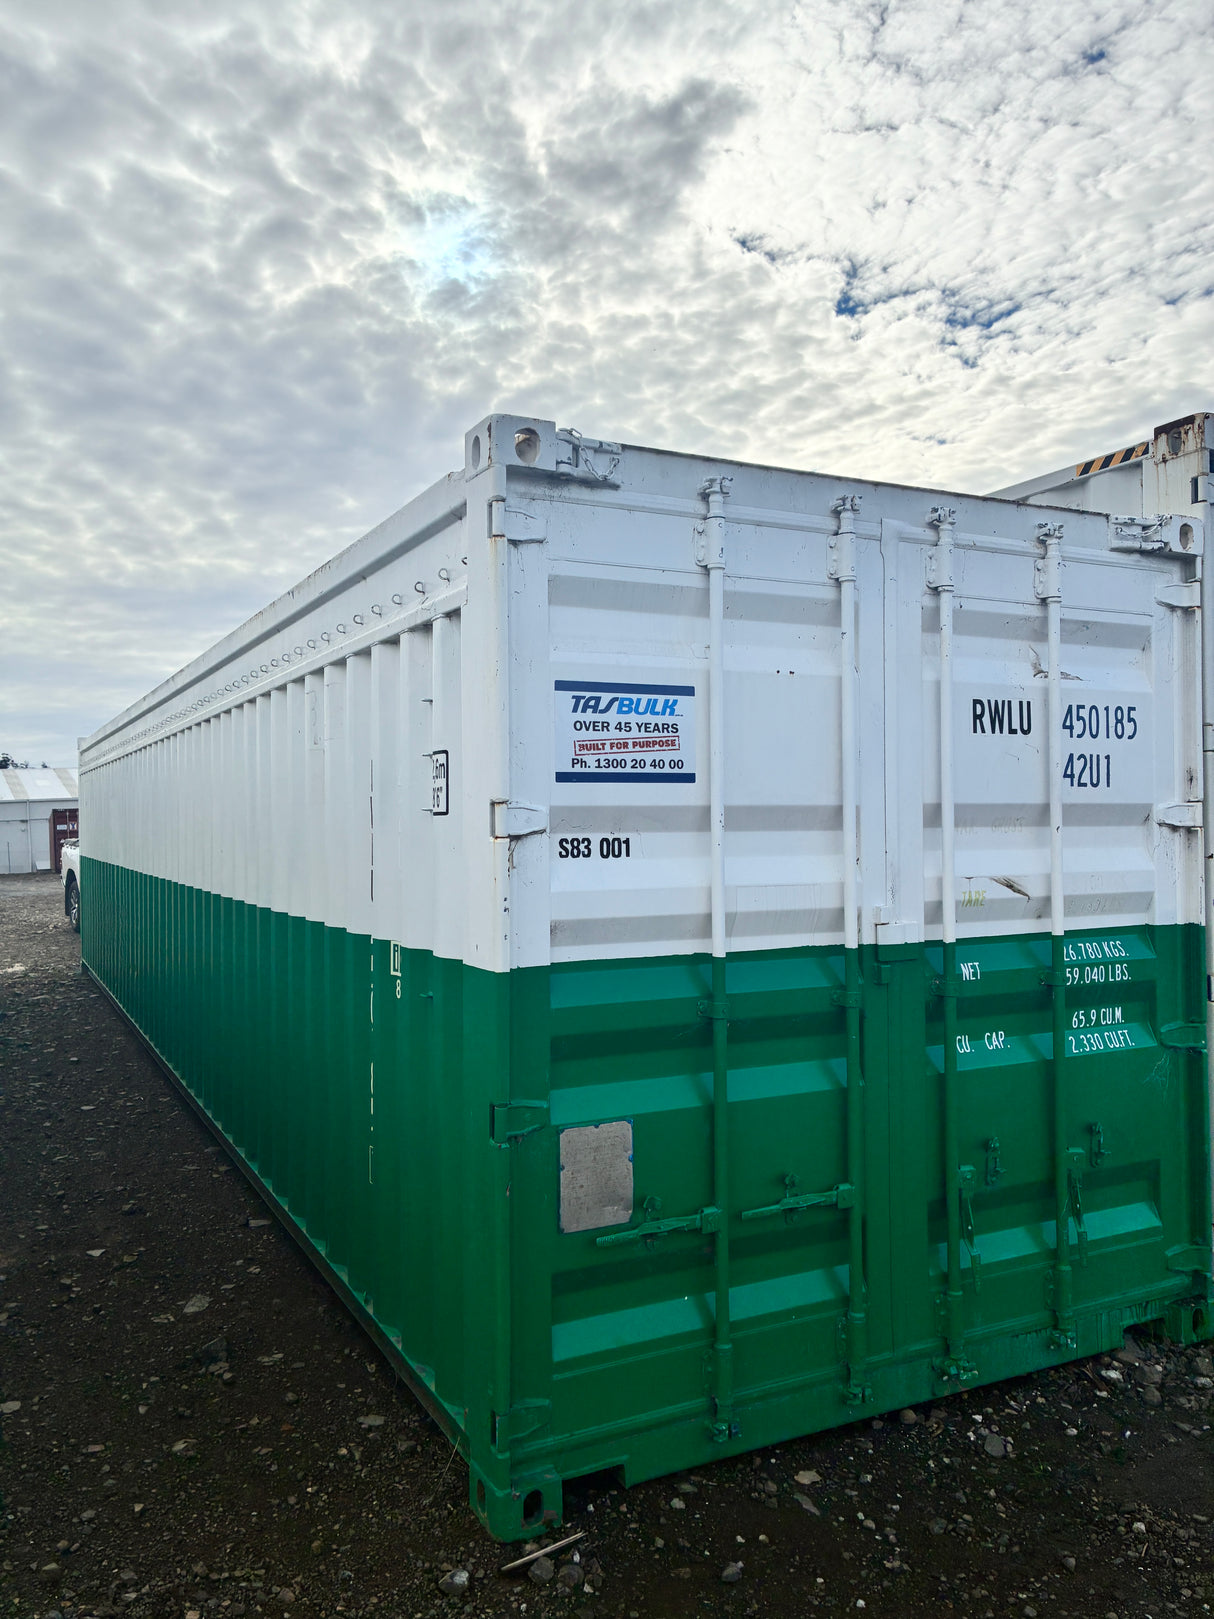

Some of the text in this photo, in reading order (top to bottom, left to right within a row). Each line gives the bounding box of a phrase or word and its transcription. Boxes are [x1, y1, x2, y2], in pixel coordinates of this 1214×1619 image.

[571, 695, 679, 717] TASBULK
[573, 720, 679, 734] OVER 45 YEARS
[972, 699, 1138, 740] RWLU 450185
[578, 739, 677, 752] BUILT FOR PURPOSE
[571, 757, 684, 770] Ph. 1300 20 40 00
[1063, 753, 1111, 788] 42U1
[558, 837, 631, 859] S83 001
[961, 891, 987, 907] TARE
[960, 962, 981, 981] NET
[1102, 940, 1130, 958] KGS.
[1066, 963, 1132, 986] 59.040 LBS.
[956, 1035, 975, 1053] CU.
[984, 1031, 1011, 1050] CAP.
[1072, 1009, 1097, 1029] 65.9
[1068, 1033, 1104, 1053] 2.330
